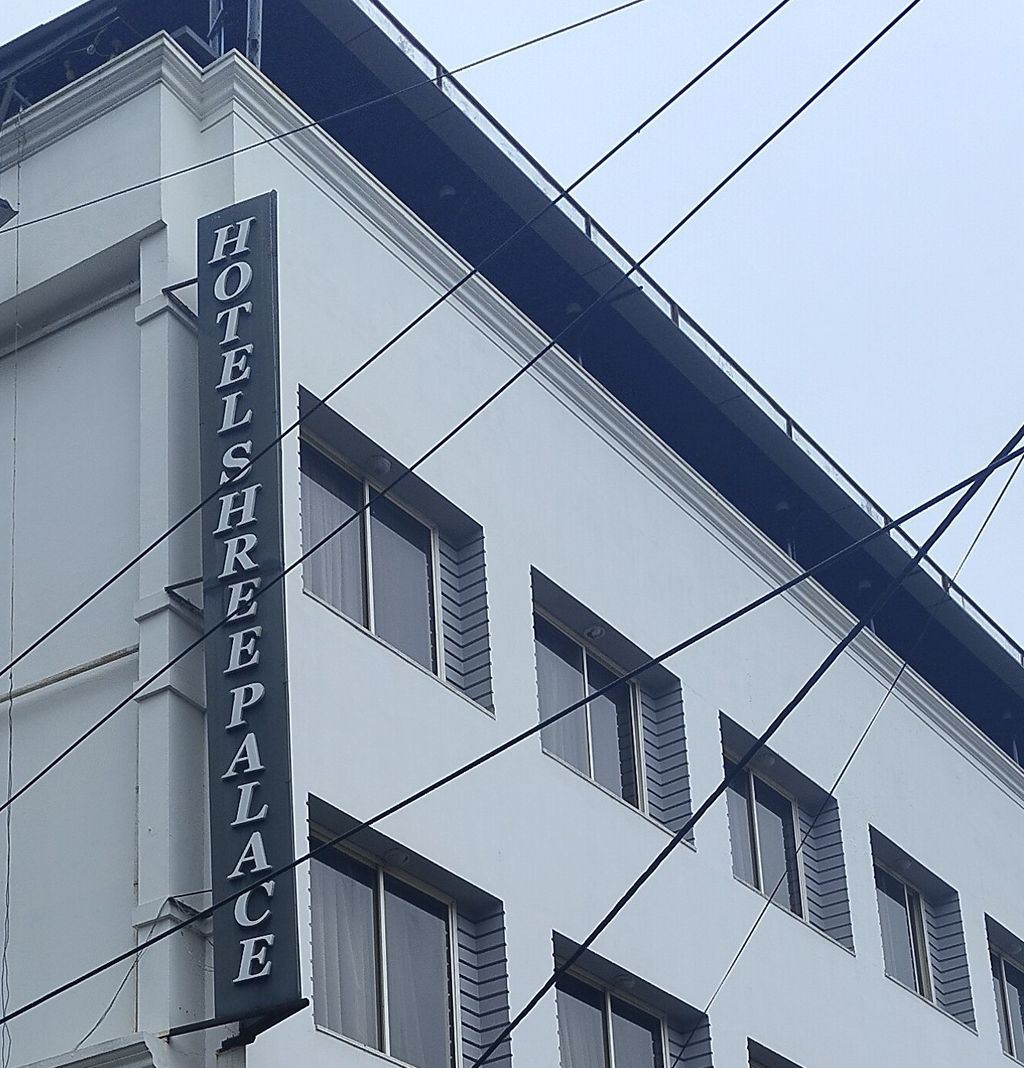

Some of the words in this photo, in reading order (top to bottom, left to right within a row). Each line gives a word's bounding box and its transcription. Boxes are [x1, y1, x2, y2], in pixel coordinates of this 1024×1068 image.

[208, 216, 256, 434] HOTEL
[213, 439, 263, 674] SHREE
[221, 682, 276, 983] PALACE
